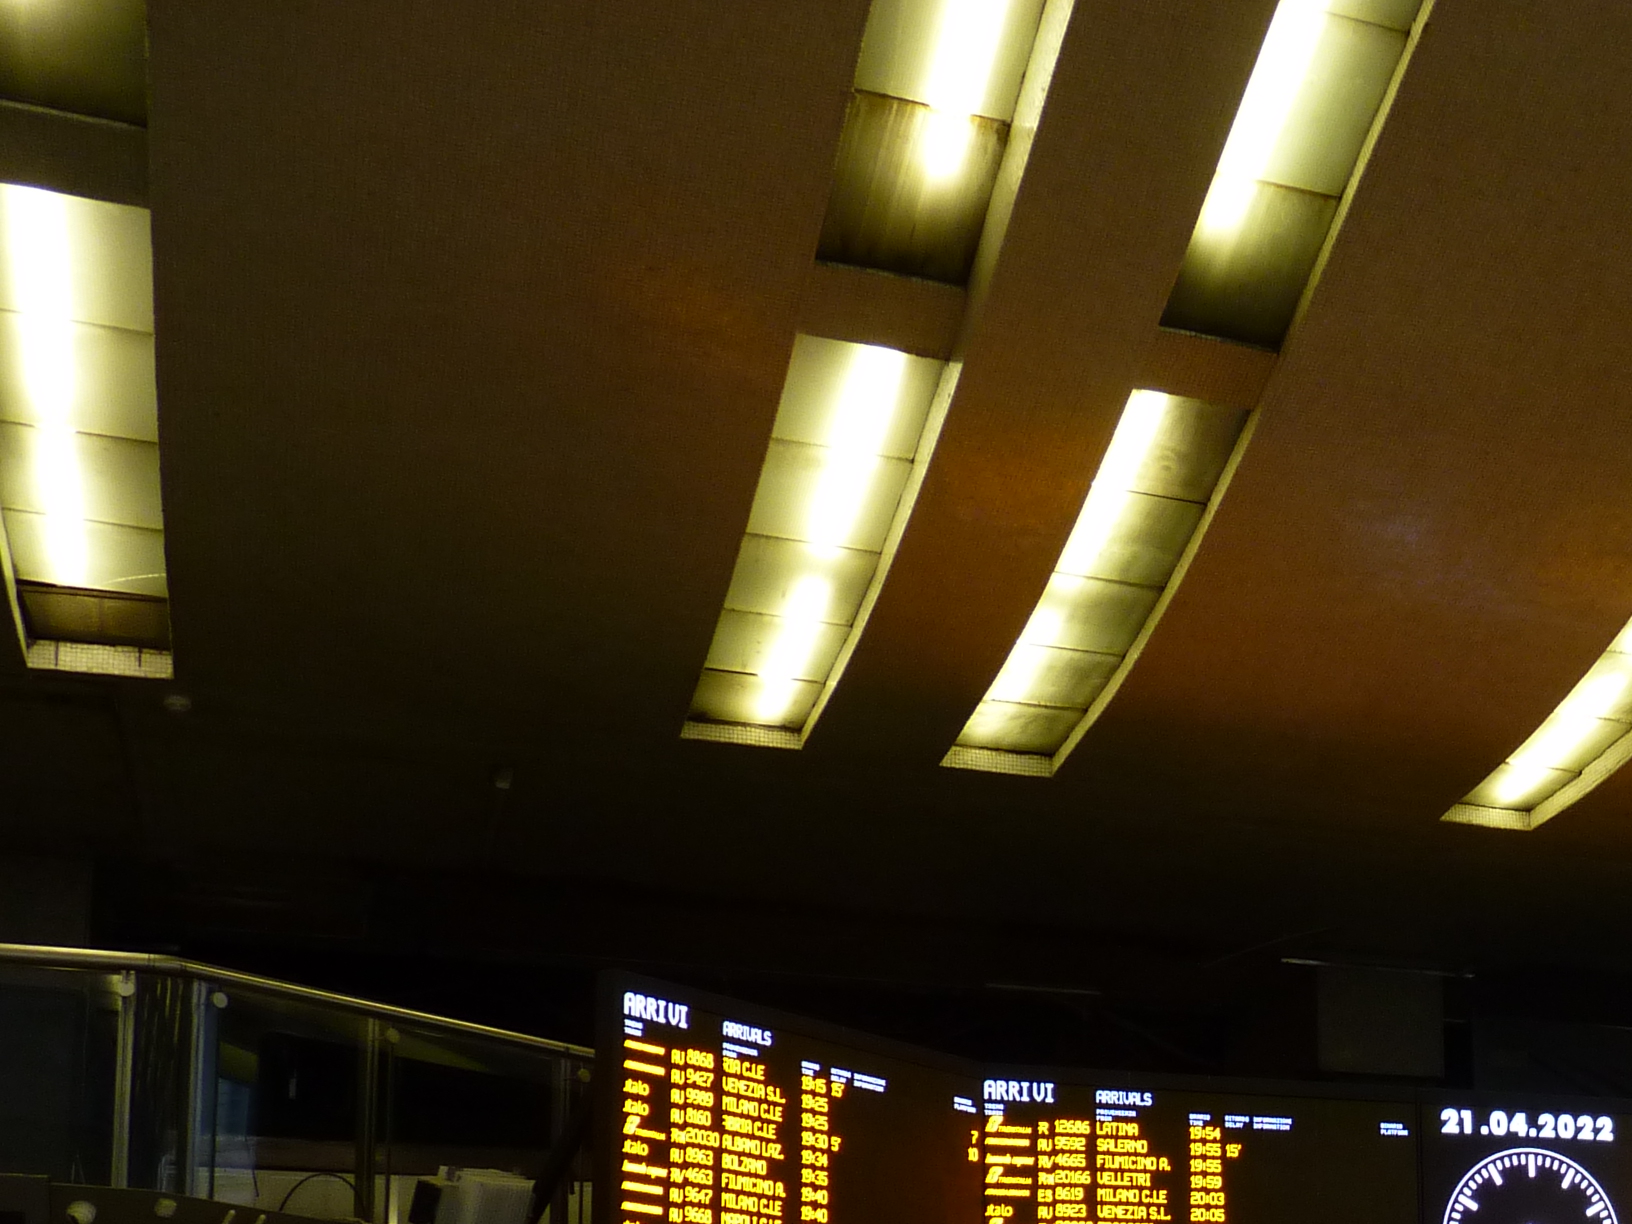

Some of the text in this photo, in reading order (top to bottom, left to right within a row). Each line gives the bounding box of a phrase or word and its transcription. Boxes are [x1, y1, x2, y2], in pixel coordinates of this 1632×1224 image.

[623, 992, 688, 1029] ARRIVI
[722, 1021, 772, 1046] ARRIVALS
[984, 1080, 1055, 1103] ARRIVI
[1096, 1090, 1152, 1106] ARRIVALS
[1440, 1108, 1614, 1141] 21.04.2022
[1190, 1127, 1221, 1140] 19:54
[1190, 1143, 1221, 1156] 19:55
[1190, 1159, 1222, 1173] 19:55
[1054, 1170, 1091, 1184] 20166
[1190, 1176, 1222, 1189] 19:59
[1190, 1192, 1225, 1206] 20:03
[1191, 1209, 1225, 1222] 20:05
